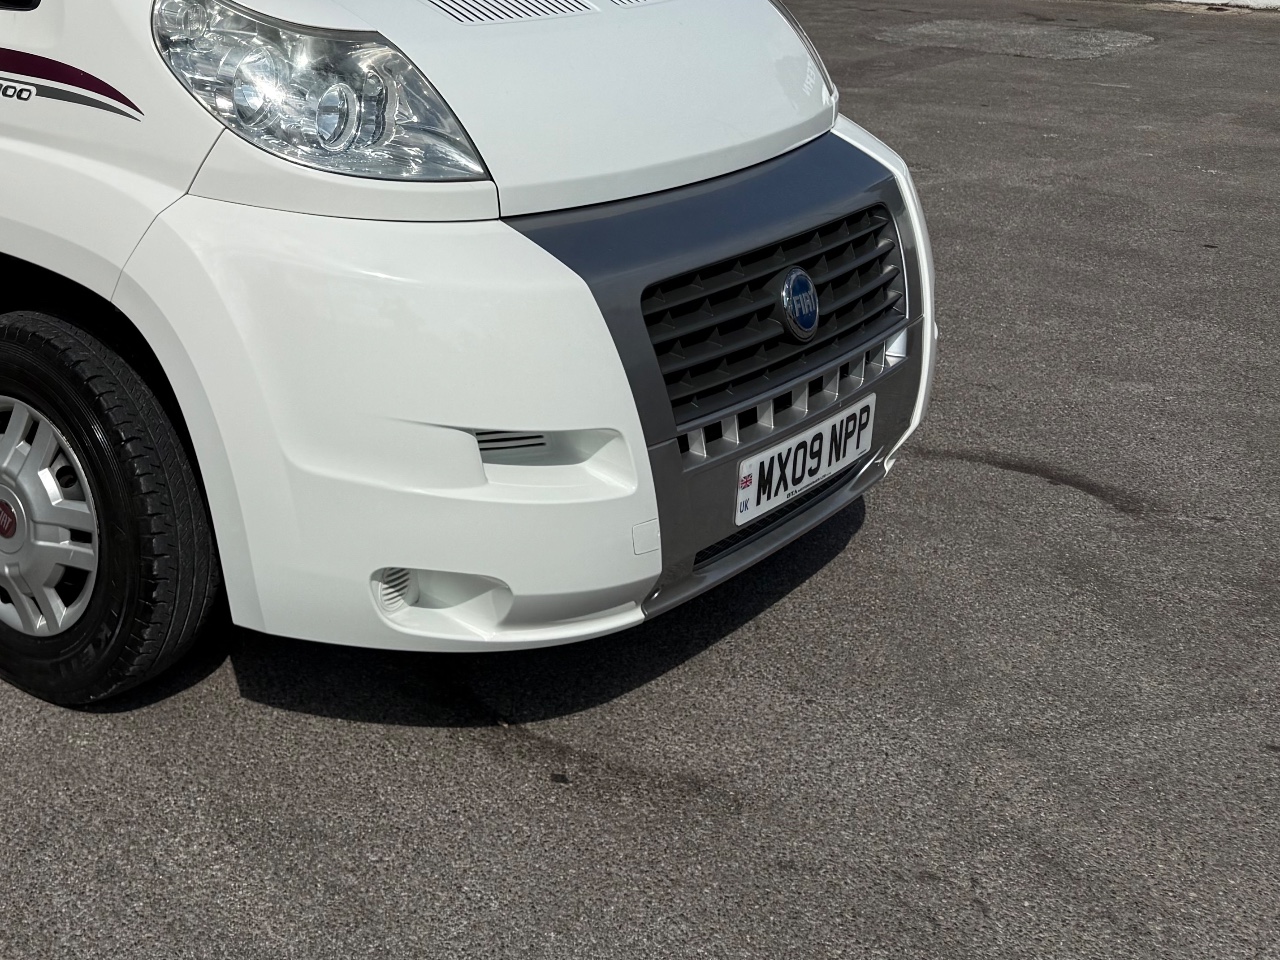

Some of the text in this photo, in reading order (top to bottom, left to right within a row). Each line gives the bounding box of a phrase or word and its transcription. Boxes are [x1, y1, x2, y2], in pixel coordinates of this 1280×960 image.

[792, 290, 817, 318] FIAT
[755, 403, 871, 507] MX09 NPP
[739, 498, 750, 514] UK
